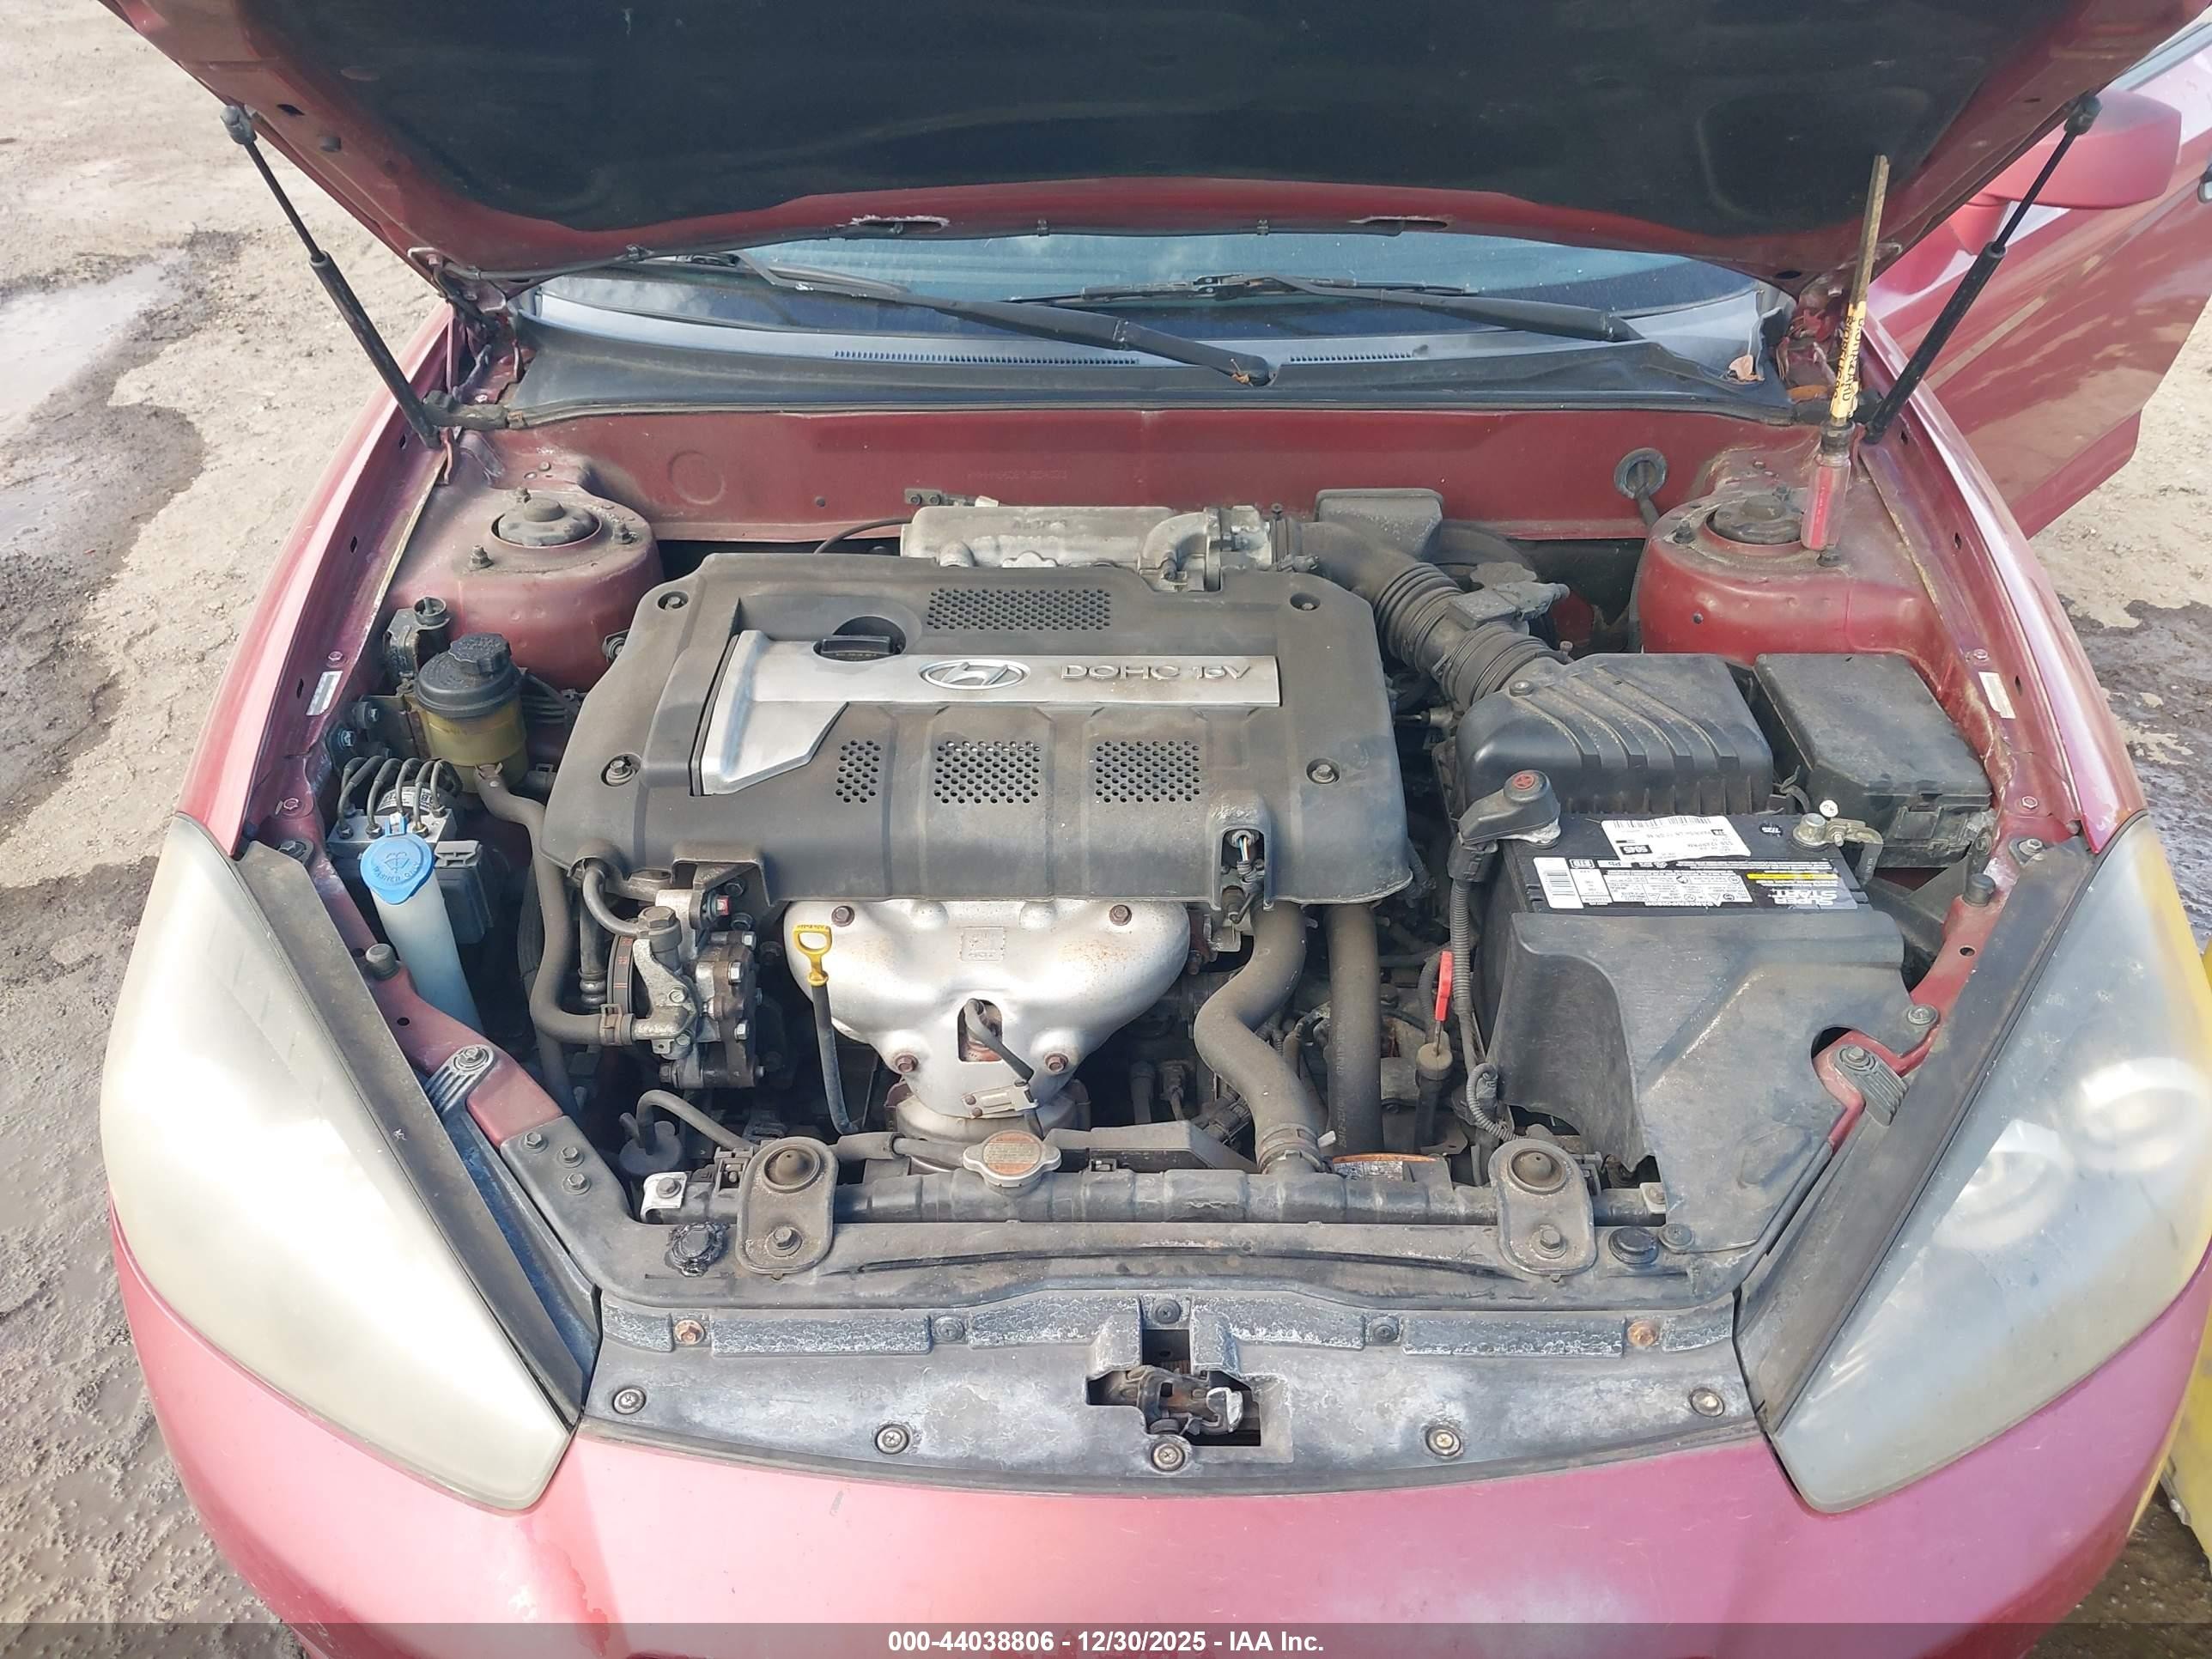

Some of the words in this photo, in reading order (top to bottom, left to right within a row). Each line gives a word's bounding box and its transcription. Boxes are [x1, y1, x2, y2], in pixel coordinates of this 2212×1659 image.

[1061, 665, 1180, 680] DOHC
[1192, 665, 1250, 680] 16V
[1771, 889, 1838, 898] START
[1773, 897, 1834, 906] SUPER
